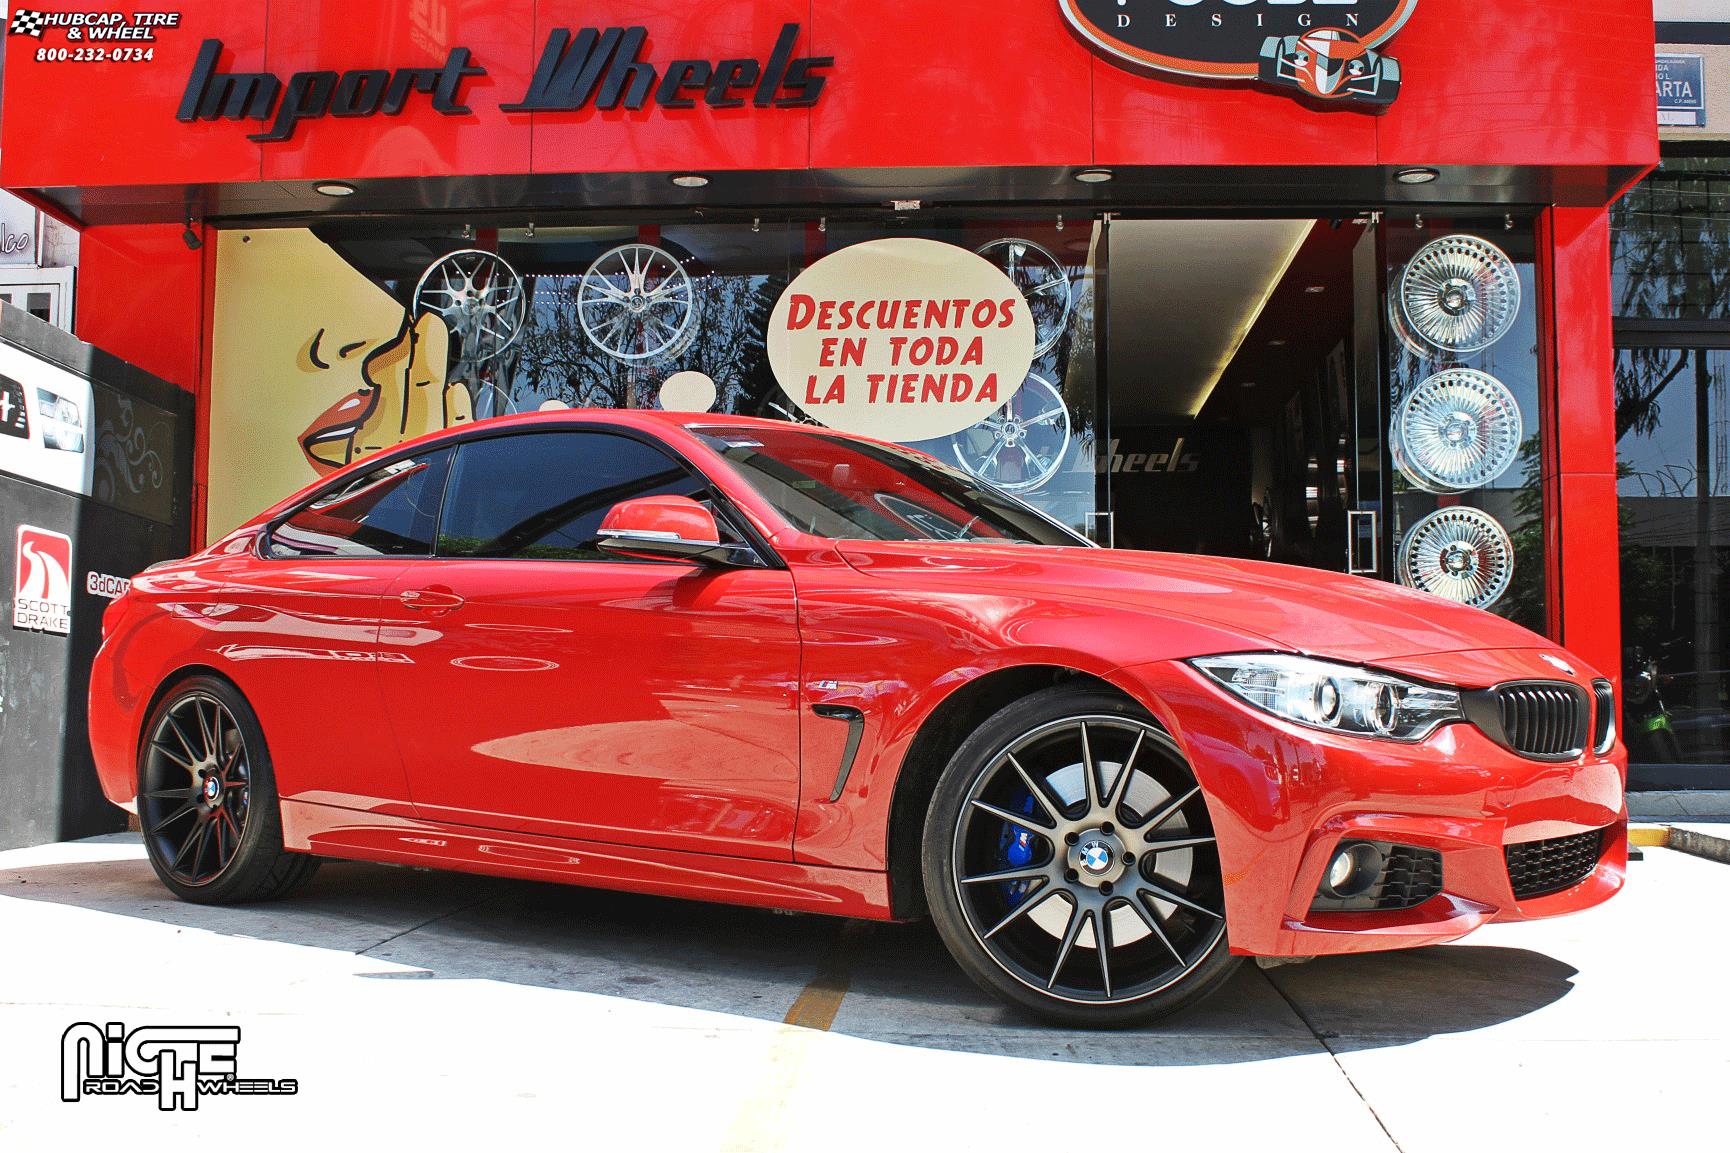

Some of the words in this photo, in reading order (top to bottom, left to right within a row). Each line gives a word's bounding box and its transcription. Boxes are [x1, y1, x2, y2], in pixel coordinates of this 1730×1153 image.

[1116, 13, 1360, 28] DESIGN
[176, 38, 487, 142] Import
[499, 23, 835, 113] Wheels
[0, 222, 29, 254] lco
[786, 294, 1016, 330] DESCUENTOS
[819, 337, 867, 367] EN
[889, 336, 983, 366] TODA
[804, 374, 845, 404] LA
[866, 373, 998, 404] TIENDA
[1082, 437, 1199, 473] heels
[17, 612, 68, 630] DRAKE
[18, 598, 69, 615] SCOTT
